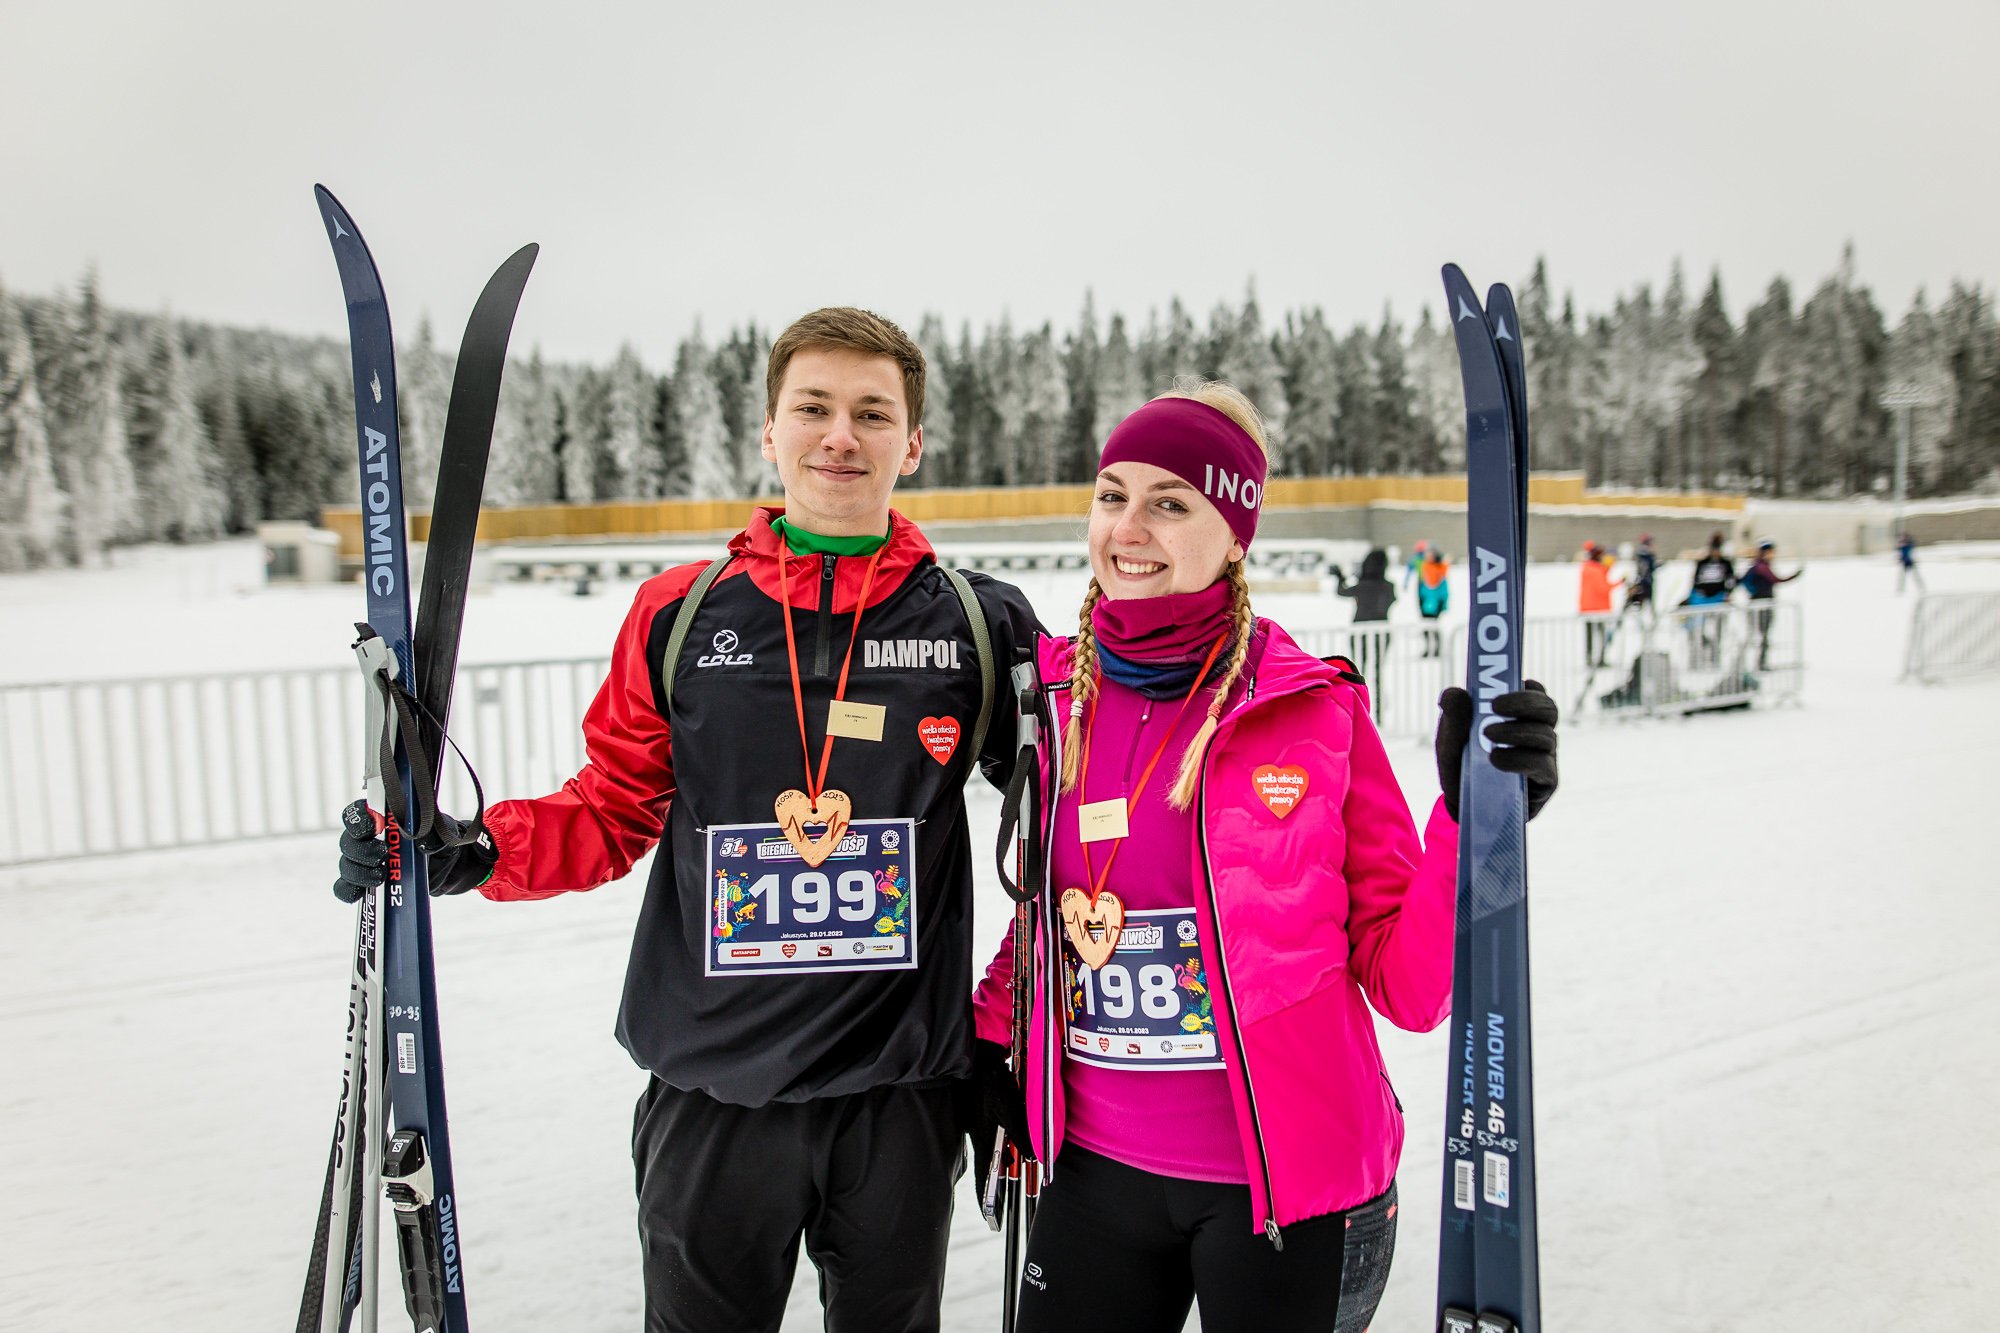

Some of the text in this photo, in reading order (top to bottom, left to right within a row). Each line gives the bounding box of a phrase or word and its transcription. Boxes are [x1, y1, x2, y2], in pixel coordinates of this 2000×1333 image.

[364, 425, 395, 597] ATOMIC
[864, 639, 961, 670] DAMPOL
[367, 893, 376, 950] ACTIVE
[390, 884, 403, 907] 52
[748, 869, 877, 926] 199
[1076, 963, 1181, 1019] 198
[1487, 1012, 1505, 1135] MOVER 46
[439, 1194, 461, 1294] ATOMIC
